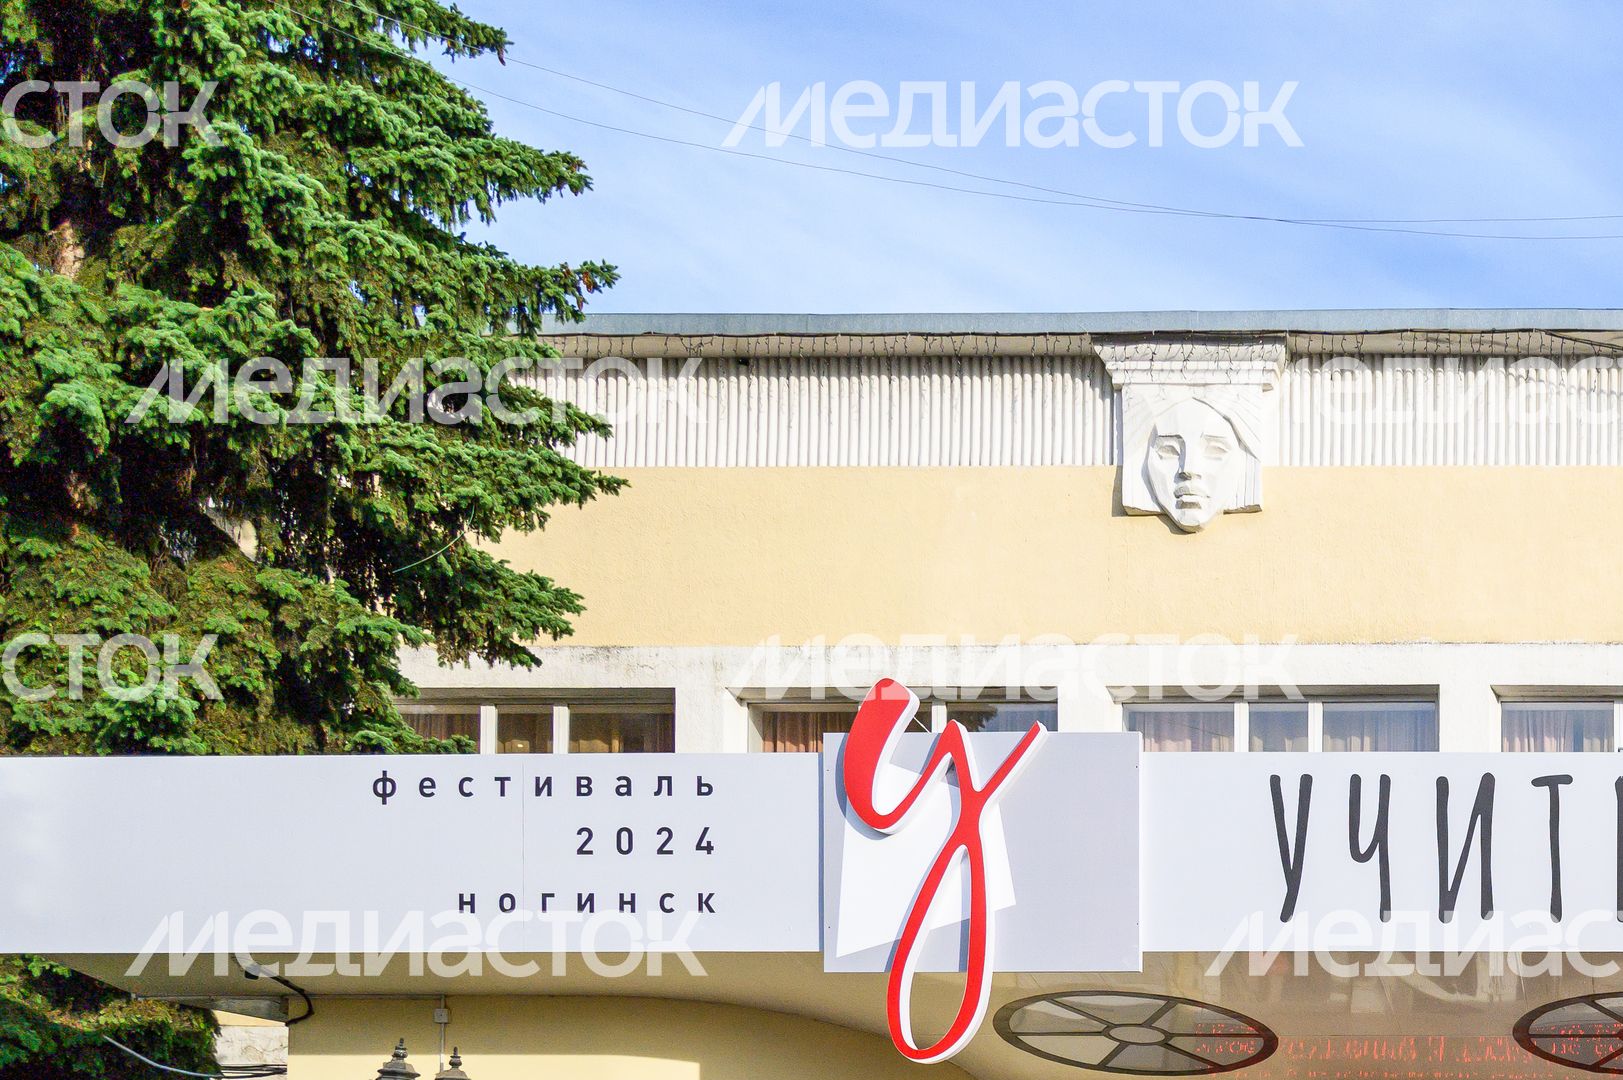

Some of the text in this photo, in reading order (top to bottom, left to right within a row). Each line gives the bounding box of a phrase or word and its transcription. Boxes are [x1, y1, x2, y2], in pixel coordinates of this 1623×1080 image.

[372, 770, 714, 805] фестиваль
[576, 826, 714, 856] 2024
[458, 892, 716, 914] ногинск
